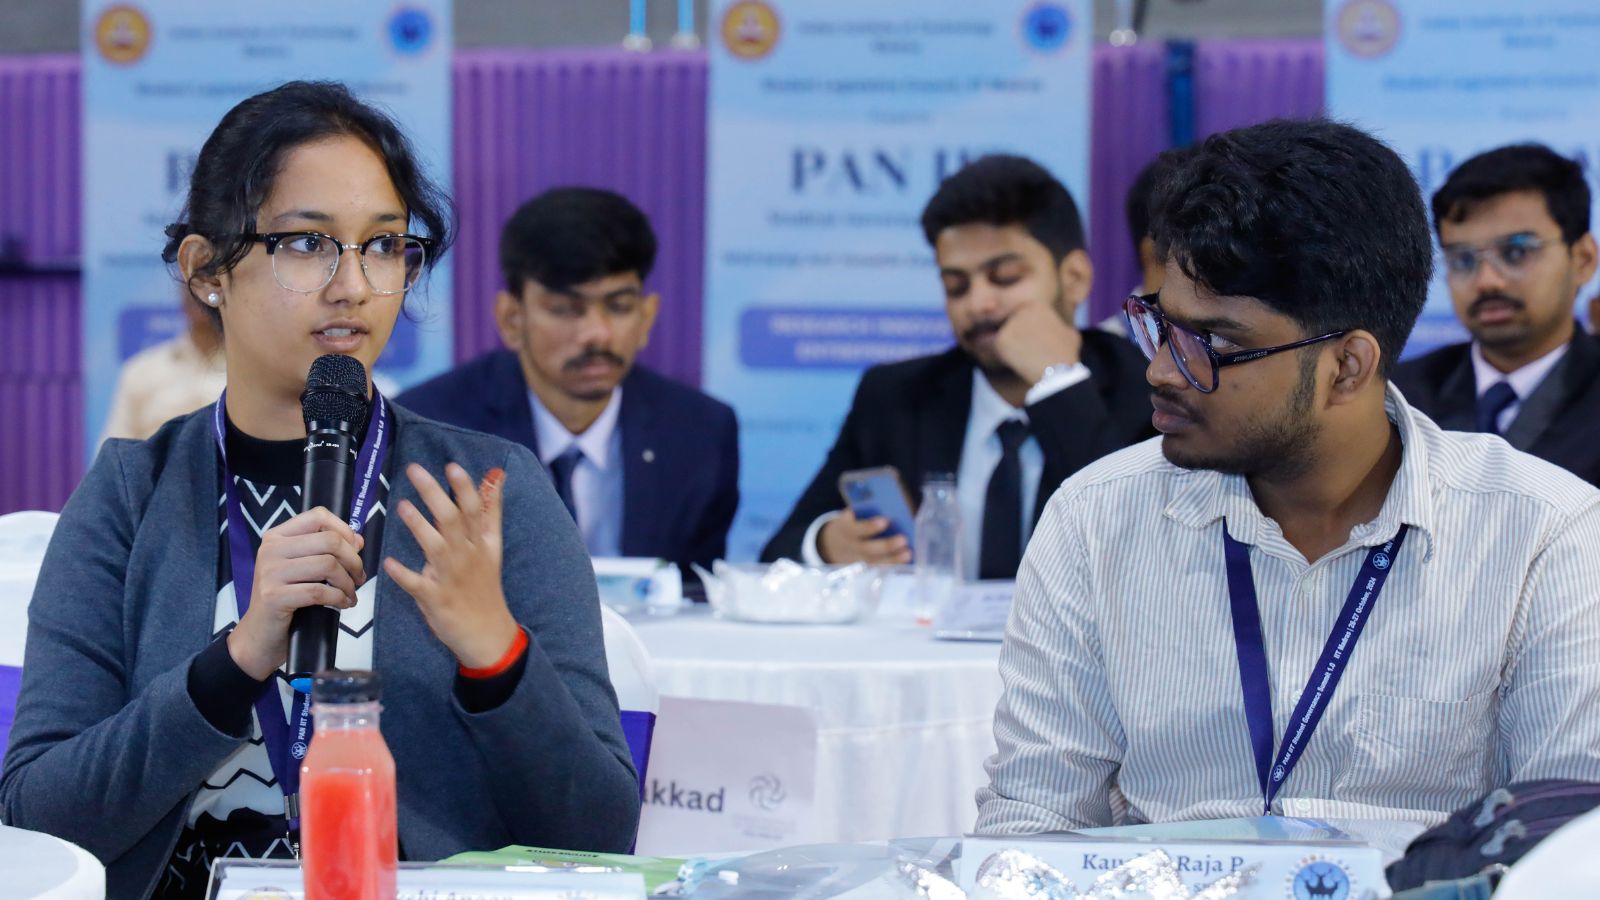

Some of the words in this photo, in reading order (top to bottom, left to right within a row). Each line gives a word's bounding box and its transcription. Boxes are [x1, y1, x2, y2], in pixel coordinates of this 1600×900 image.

[791, 148, 906, 193] PAN
[364, 449, 378, 479] Governance
[358, 478, 371, 499] Student
[352, 506, 361, 518] PAN
[1366, 576, 1376, 591] 2024
[1355, 591, 1372, 614] October,
[1337, 631, 1351, 651] Madras
[1333, 650, 1342, 659] IIT
[1327, 662, 1336, 672] 1.0
[1317, 671, 1332, 692] Summit
[1302, 692, 1321, 724] Governance
[298, 727, 306, 740] PAN
[1292, 723, 1306, 745] Student
[1282, 752, 1292, 765] PAN
[1177, 854, 1222, 876] Raja
[1230, 856, 1244, 873] P
